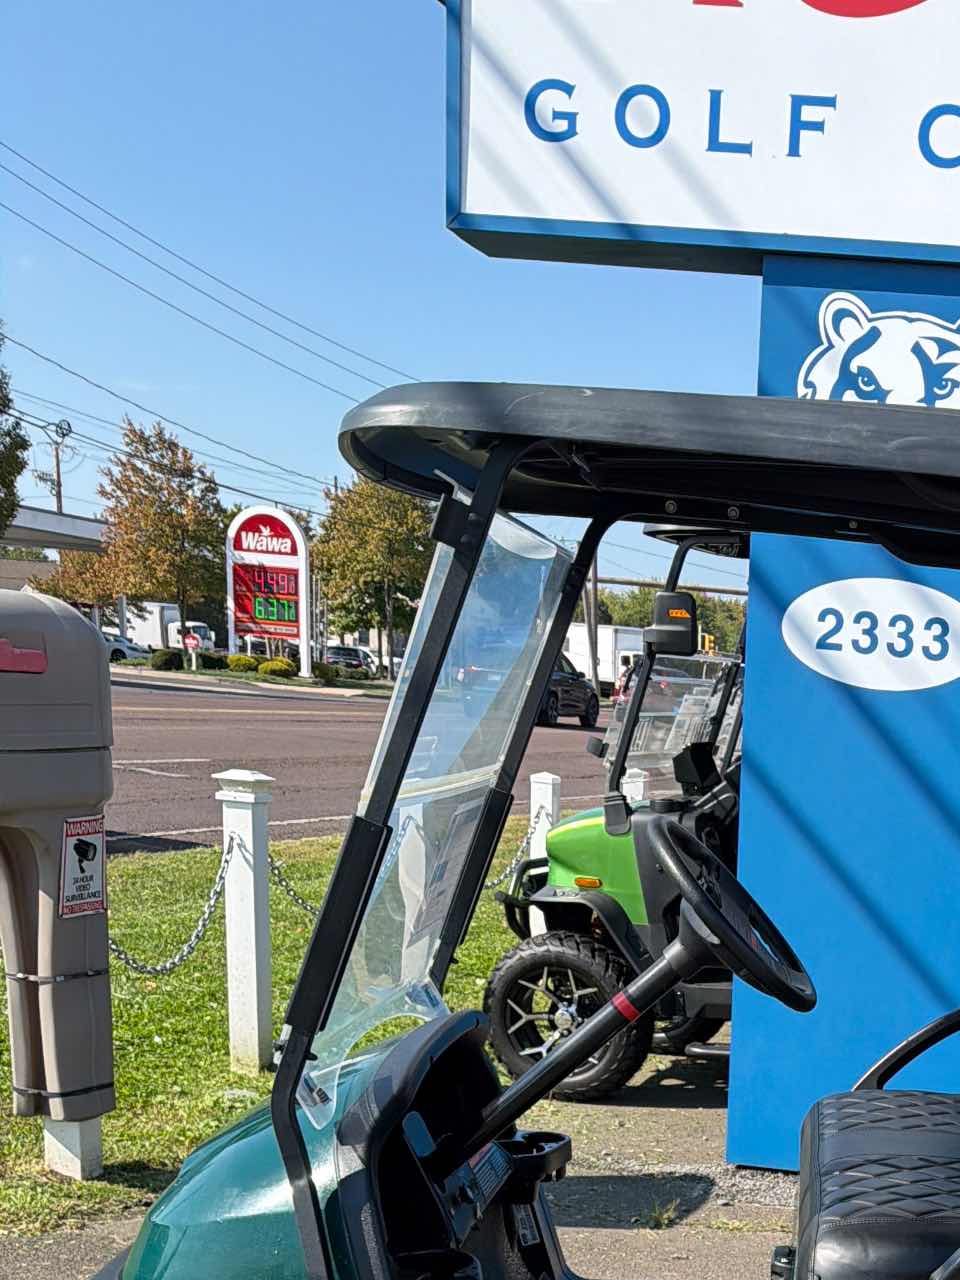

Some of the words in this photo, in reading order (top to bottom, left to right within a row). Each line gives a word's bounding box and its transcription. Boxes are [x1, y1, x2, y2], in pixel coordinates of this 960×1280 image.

[523, 78, 838, 158] GOLF
[241, 530, 292, 553] Wawa
[815, 607, 950, 662] 2333
[66, 820, 103, 836] WARNING
